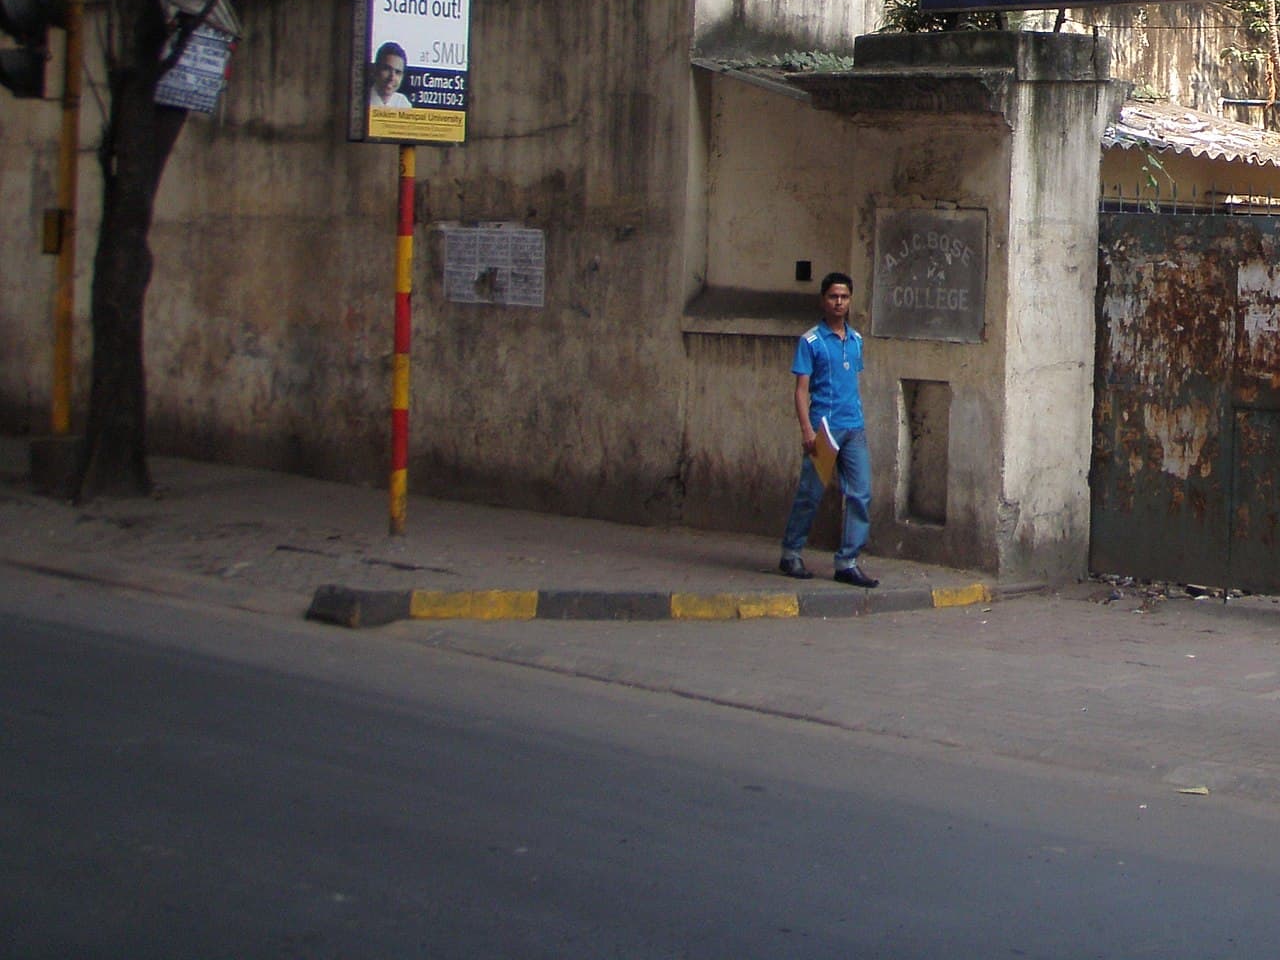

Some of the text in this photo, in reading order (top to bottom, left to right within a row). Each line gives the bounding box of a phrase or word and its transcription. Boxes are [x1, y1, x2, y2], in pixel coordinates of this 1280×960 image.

[419, 41, 466, 65] at SMU
[410, 73, 465, 90] 1/1 Camac St
[418, 91, 464, 106] 30221150-2
[427, 113, 463, 124] University
[893, 286, 969, 311] COLLEGE
